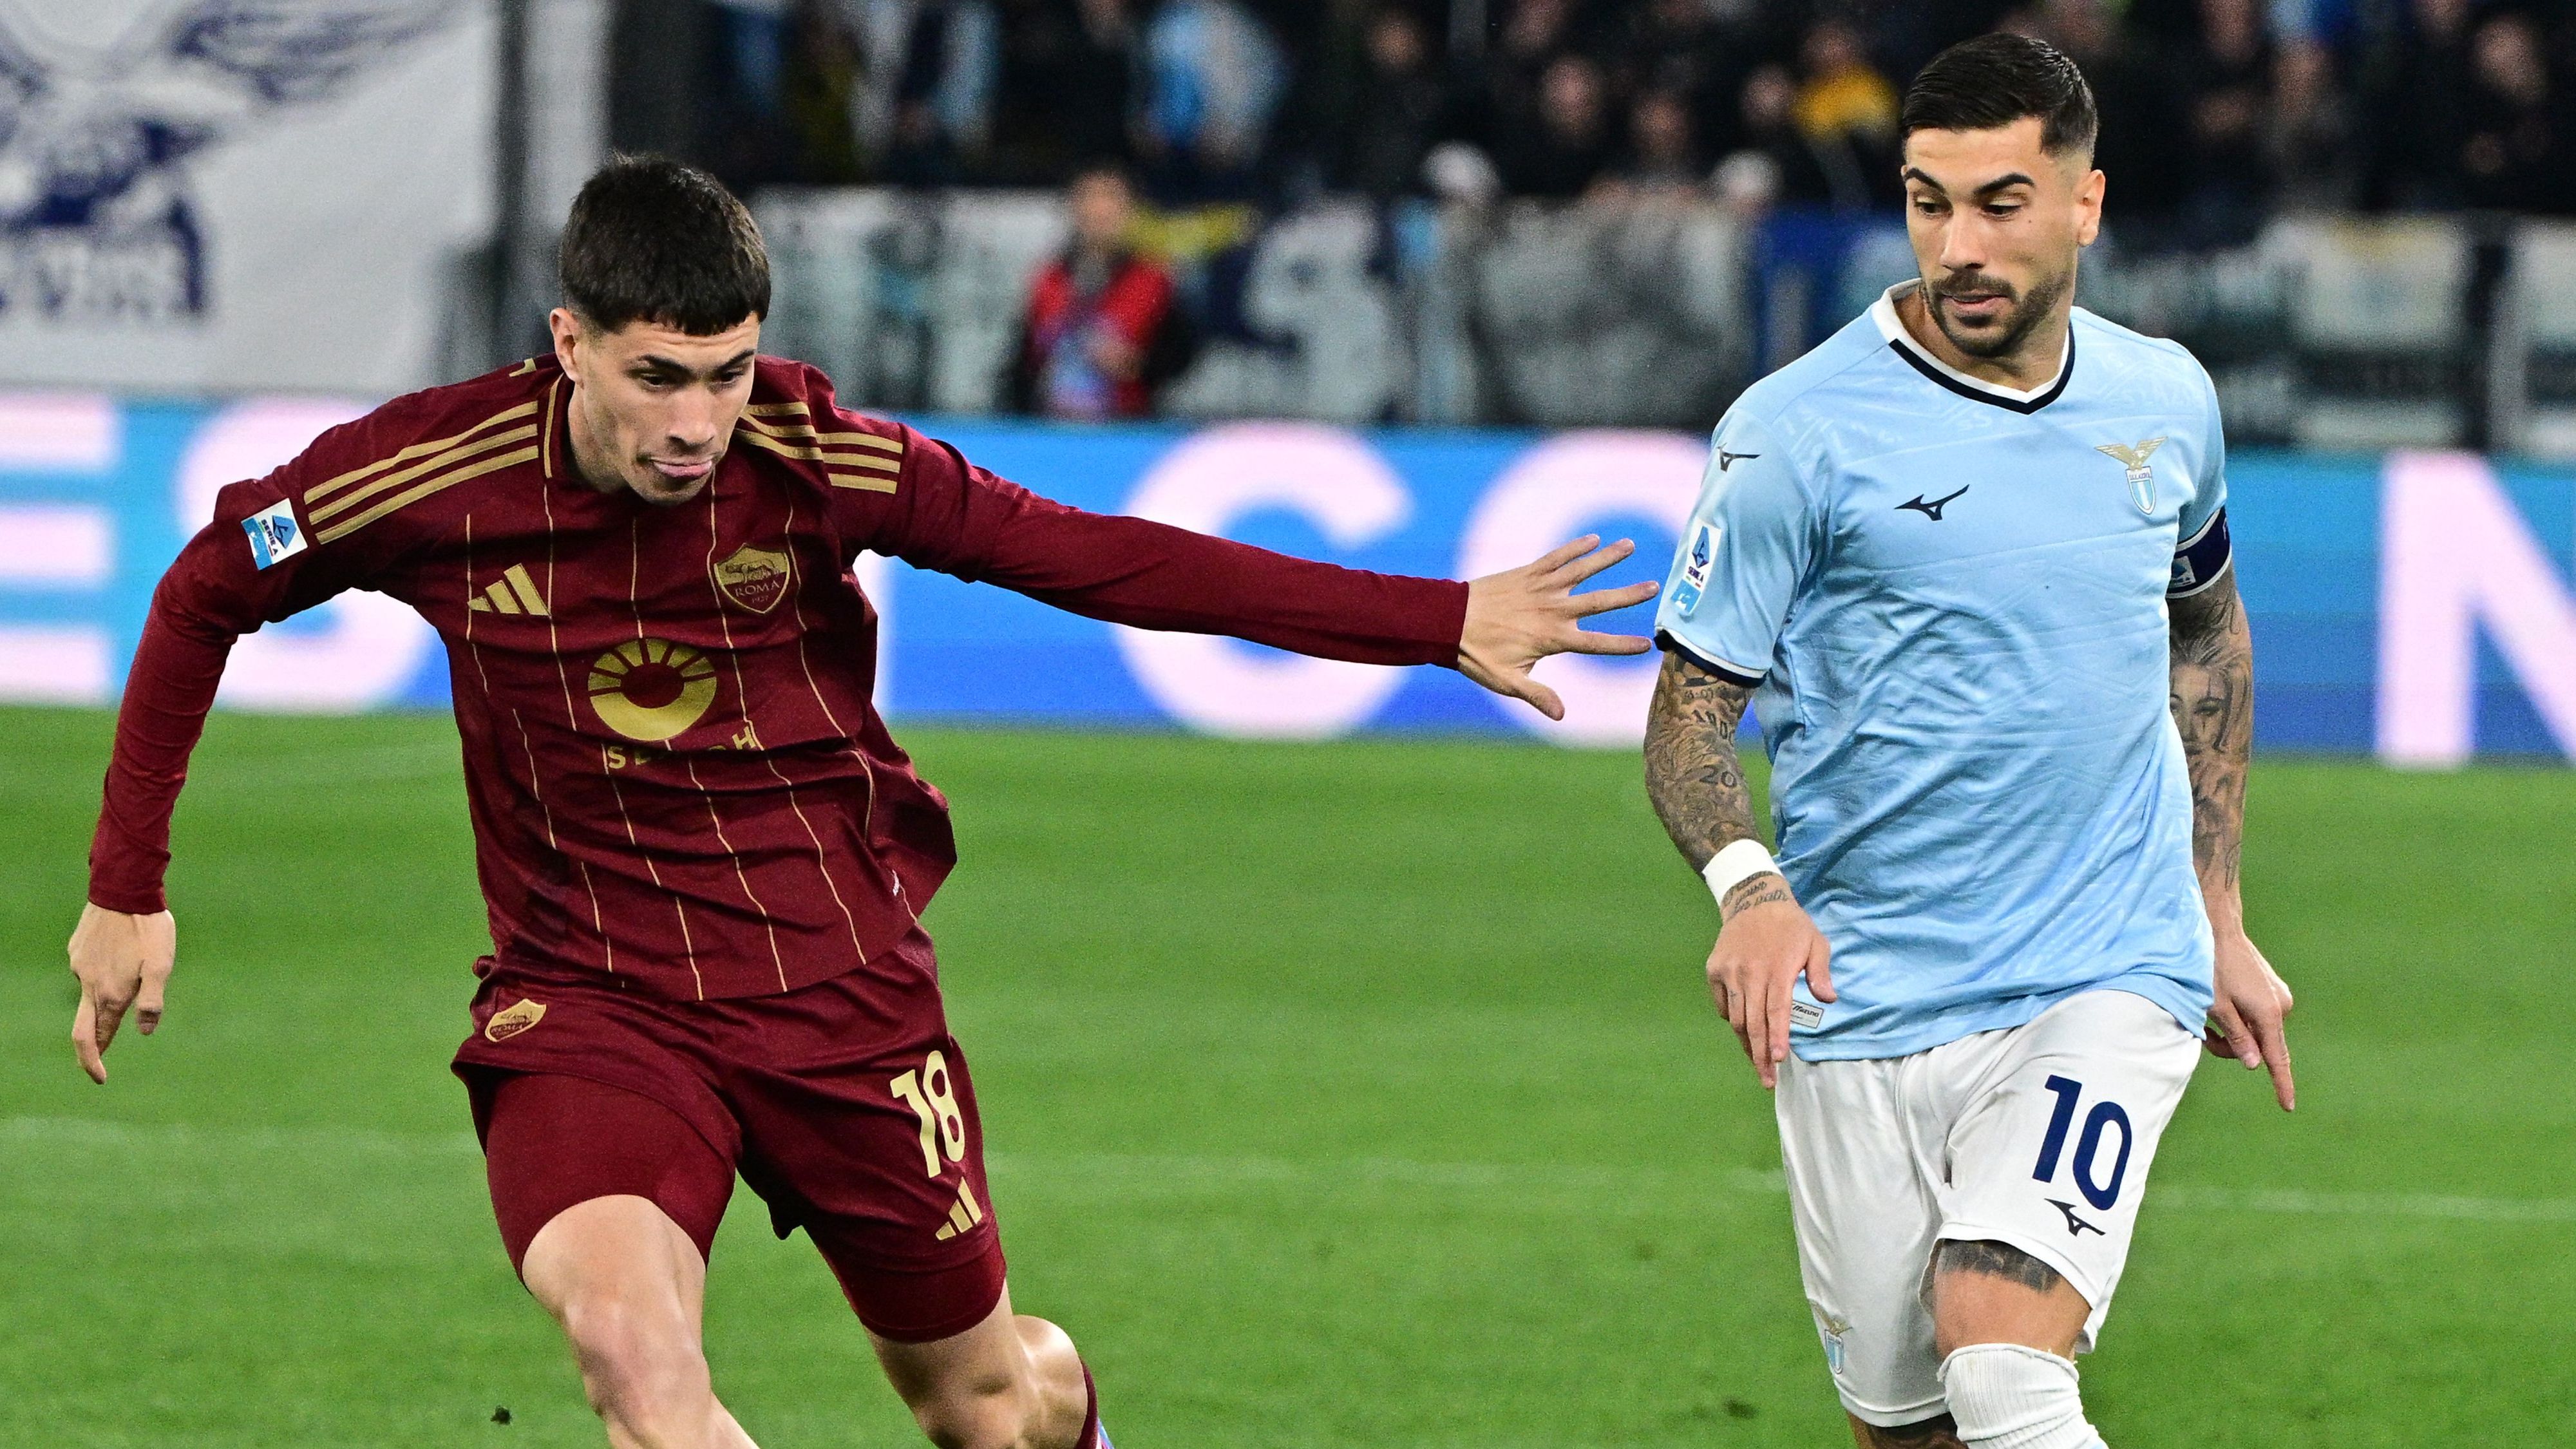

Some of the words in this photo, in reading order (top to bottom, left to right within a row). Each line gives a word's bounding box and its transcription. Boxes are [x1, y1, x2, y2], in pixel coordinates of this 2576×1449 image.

[261, 519, 276, 546] SERIE
[735, 580, 781, 598] ROMA
[889, 1050, 965, 1179] 18
[2031, 1074, 2133, 1211] 10
